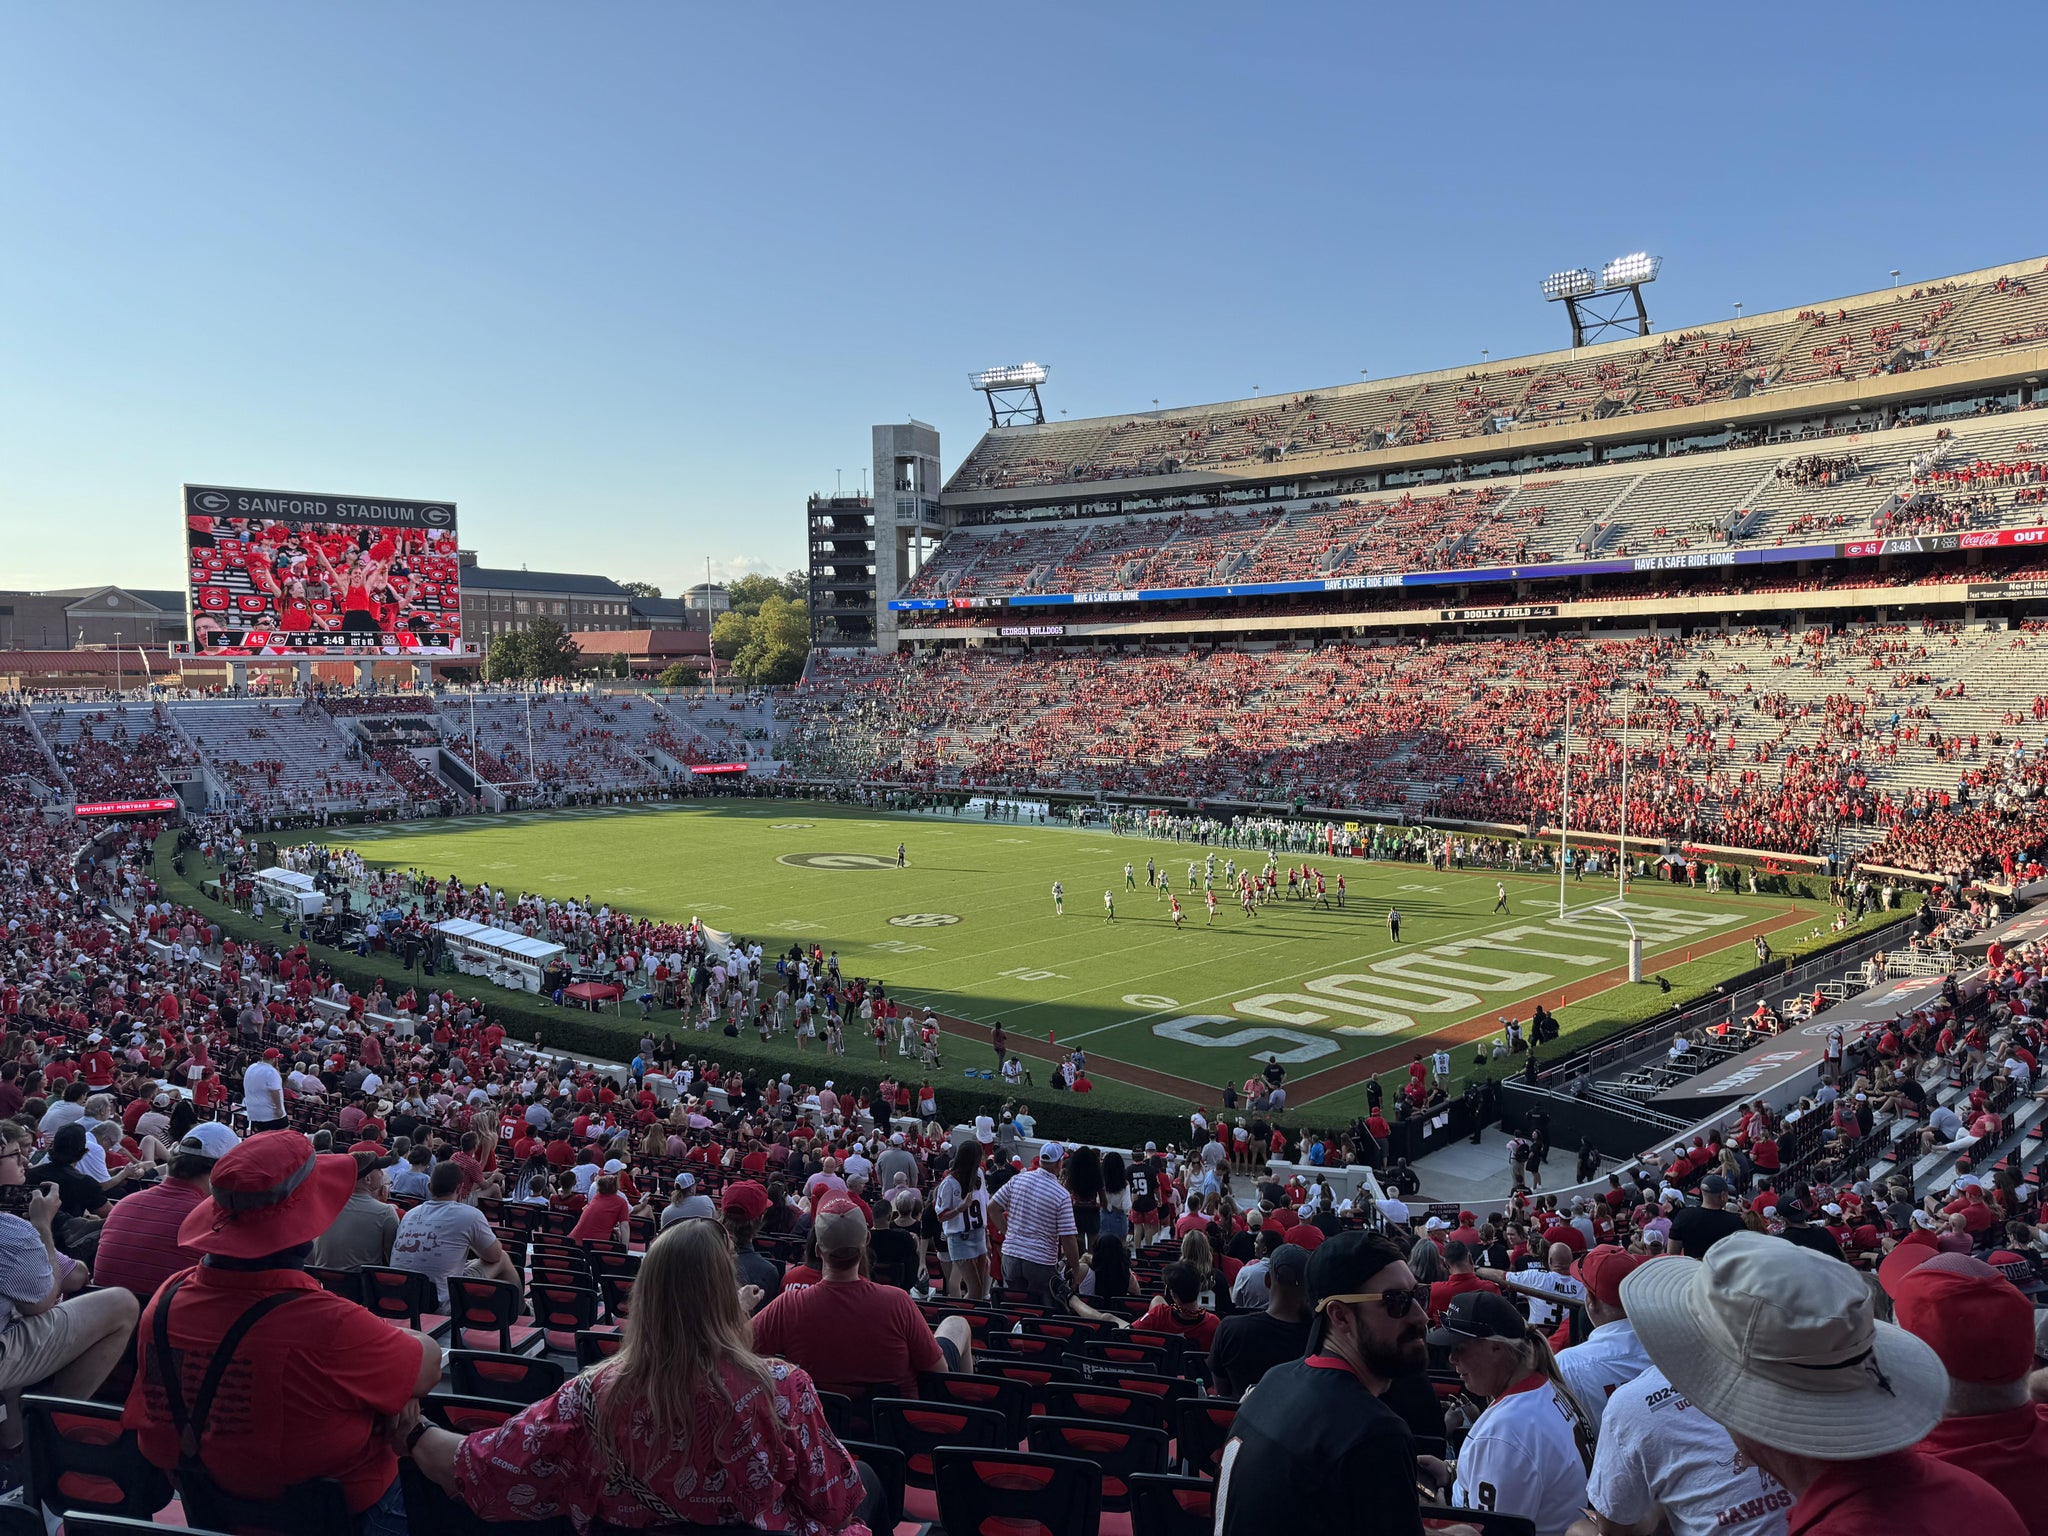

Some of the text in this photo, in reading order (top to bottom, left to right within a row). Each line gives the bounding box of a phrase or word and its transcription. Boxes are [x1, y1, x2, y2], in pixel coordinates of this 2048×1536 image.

[238, 496, 415, 521] SANFORD STADIUM
[2014, 531, 2044, 542] OUT
[1865, 544, 1876, 554] 45
[1891, 541, 1910, 552] 3:48
[1932, 538, 1938, 549] 7
[1634, 552, 1735, 570] HAVE A SAFE RIDE HOME
[1325, 576, 1403, 590] HAVE A SAFE RIDE HOME
[1073, 595, 1088, 603] HAVE
[1094, 594, 1108, 602] SAFE
[1109, 593, 1122, 601] RIDE
[1123, 592, 1140, 600] HOME
[1464, 609, 1502, 619] DOOLEY
[1504, 607, 1531, 617] FIELD
[1001, 626, 1064, 636] GEORGIA BULLDOGS
[251, 635, 264, 643] 45
[295, 637, 302, 645] 15
[323, 636, 345, 645] 3:48
[77, 805, 115, 813] SOUTHEAST
[997, 967, 1056, 982] 10
[90, 1058, 97, 1073] 1
[678, 1075, 685, 1086] 14
[500, 1125, 515, 1140] 19
[1133, 1178, 1148, 1196] 19
[730, 1432, 763, 1462] GEORGIA
[491, 1456, 528, 1476] GEORGIA
[810, 1474, 842, 1497] GEORGIA
[689, 1495, 733, 1505] GEORGIA
[1716, 1489, 1792, 1527] DAWGS
